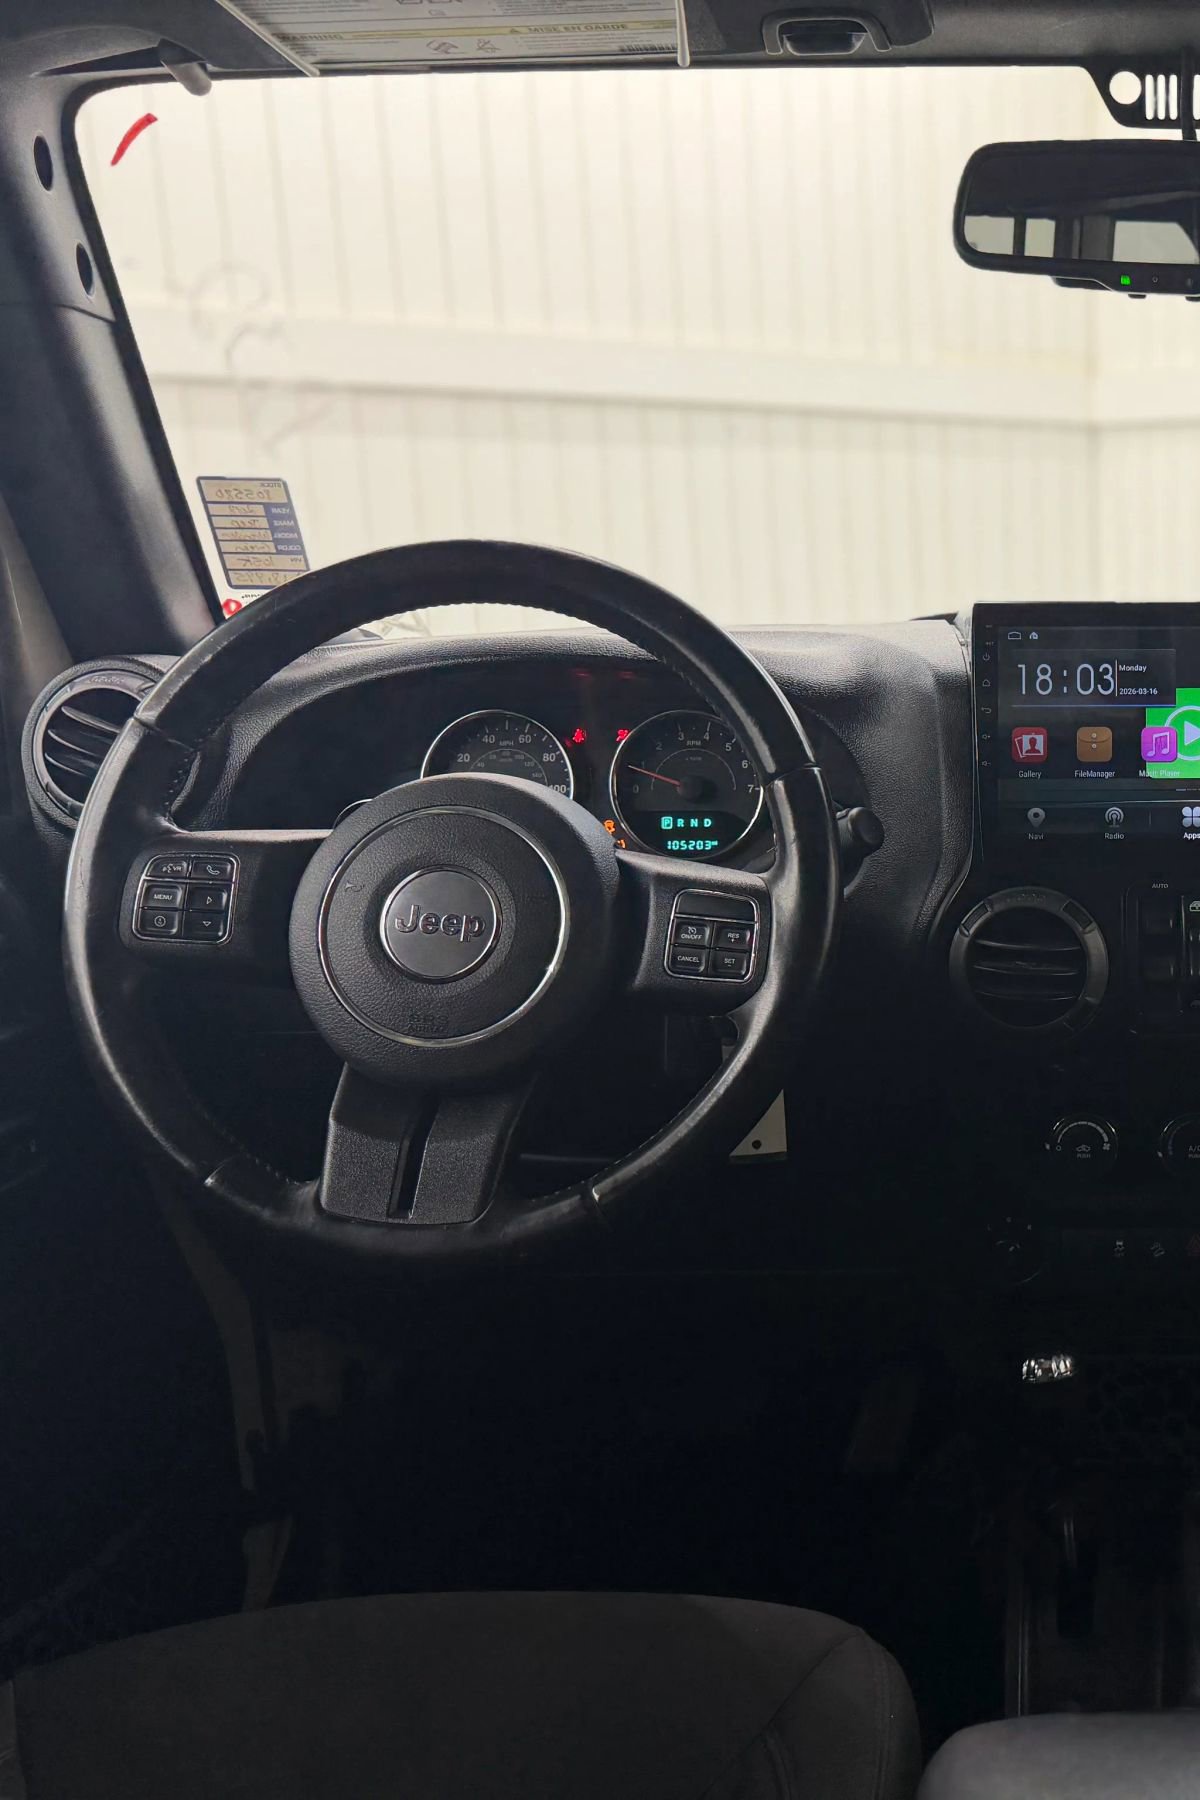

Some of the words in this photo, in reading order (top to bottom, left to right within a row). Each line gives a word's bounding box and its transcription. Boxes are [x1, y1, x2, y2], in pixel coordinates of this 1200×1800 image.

[528, 26, 562, 34] MISE
[564, 25, 584, 33] EN
[585, 23, 629, 32] GARDE
[1118, 664, 1147, 673] Monday
[1017, 663, 1115, 696] 18:03
[1119, 687, 1158, 695] 2026-03-16
[482, 734, 496, 744] 40
[518, 734, 532, 744] 60
[678, 732, 685, 741] 3
[703, 732, 710, 741] 4
[655, 742, 663, 751] 2
[725, 742, 732, 752] 5
[457, 753, 471, 763] 20
[542, 752, 556, 762] 80
[741, 759, 748, 769] 6
[1018, 769, 1042, 780] Gallery
[1074, 769, 1116, 779] FileManager
[632, 784, 640, 794] 0
[747, 784, 754, 794] 7
[677, 818, 684, 828] R
[690, 818, 699, 828] N
[703, 818, 712, 828] D
[1028, 832, 1044, 840] Navi
[1104, 832, 1125, 840] Radio
[1183, 832, 1200, 840] Apps
[667, 840, 712, 850] 105203
[153, 893, 173, 901] MENU
[395, 904, 486, 942] Jeep
[677, 955, 700, 963] CANCEL
